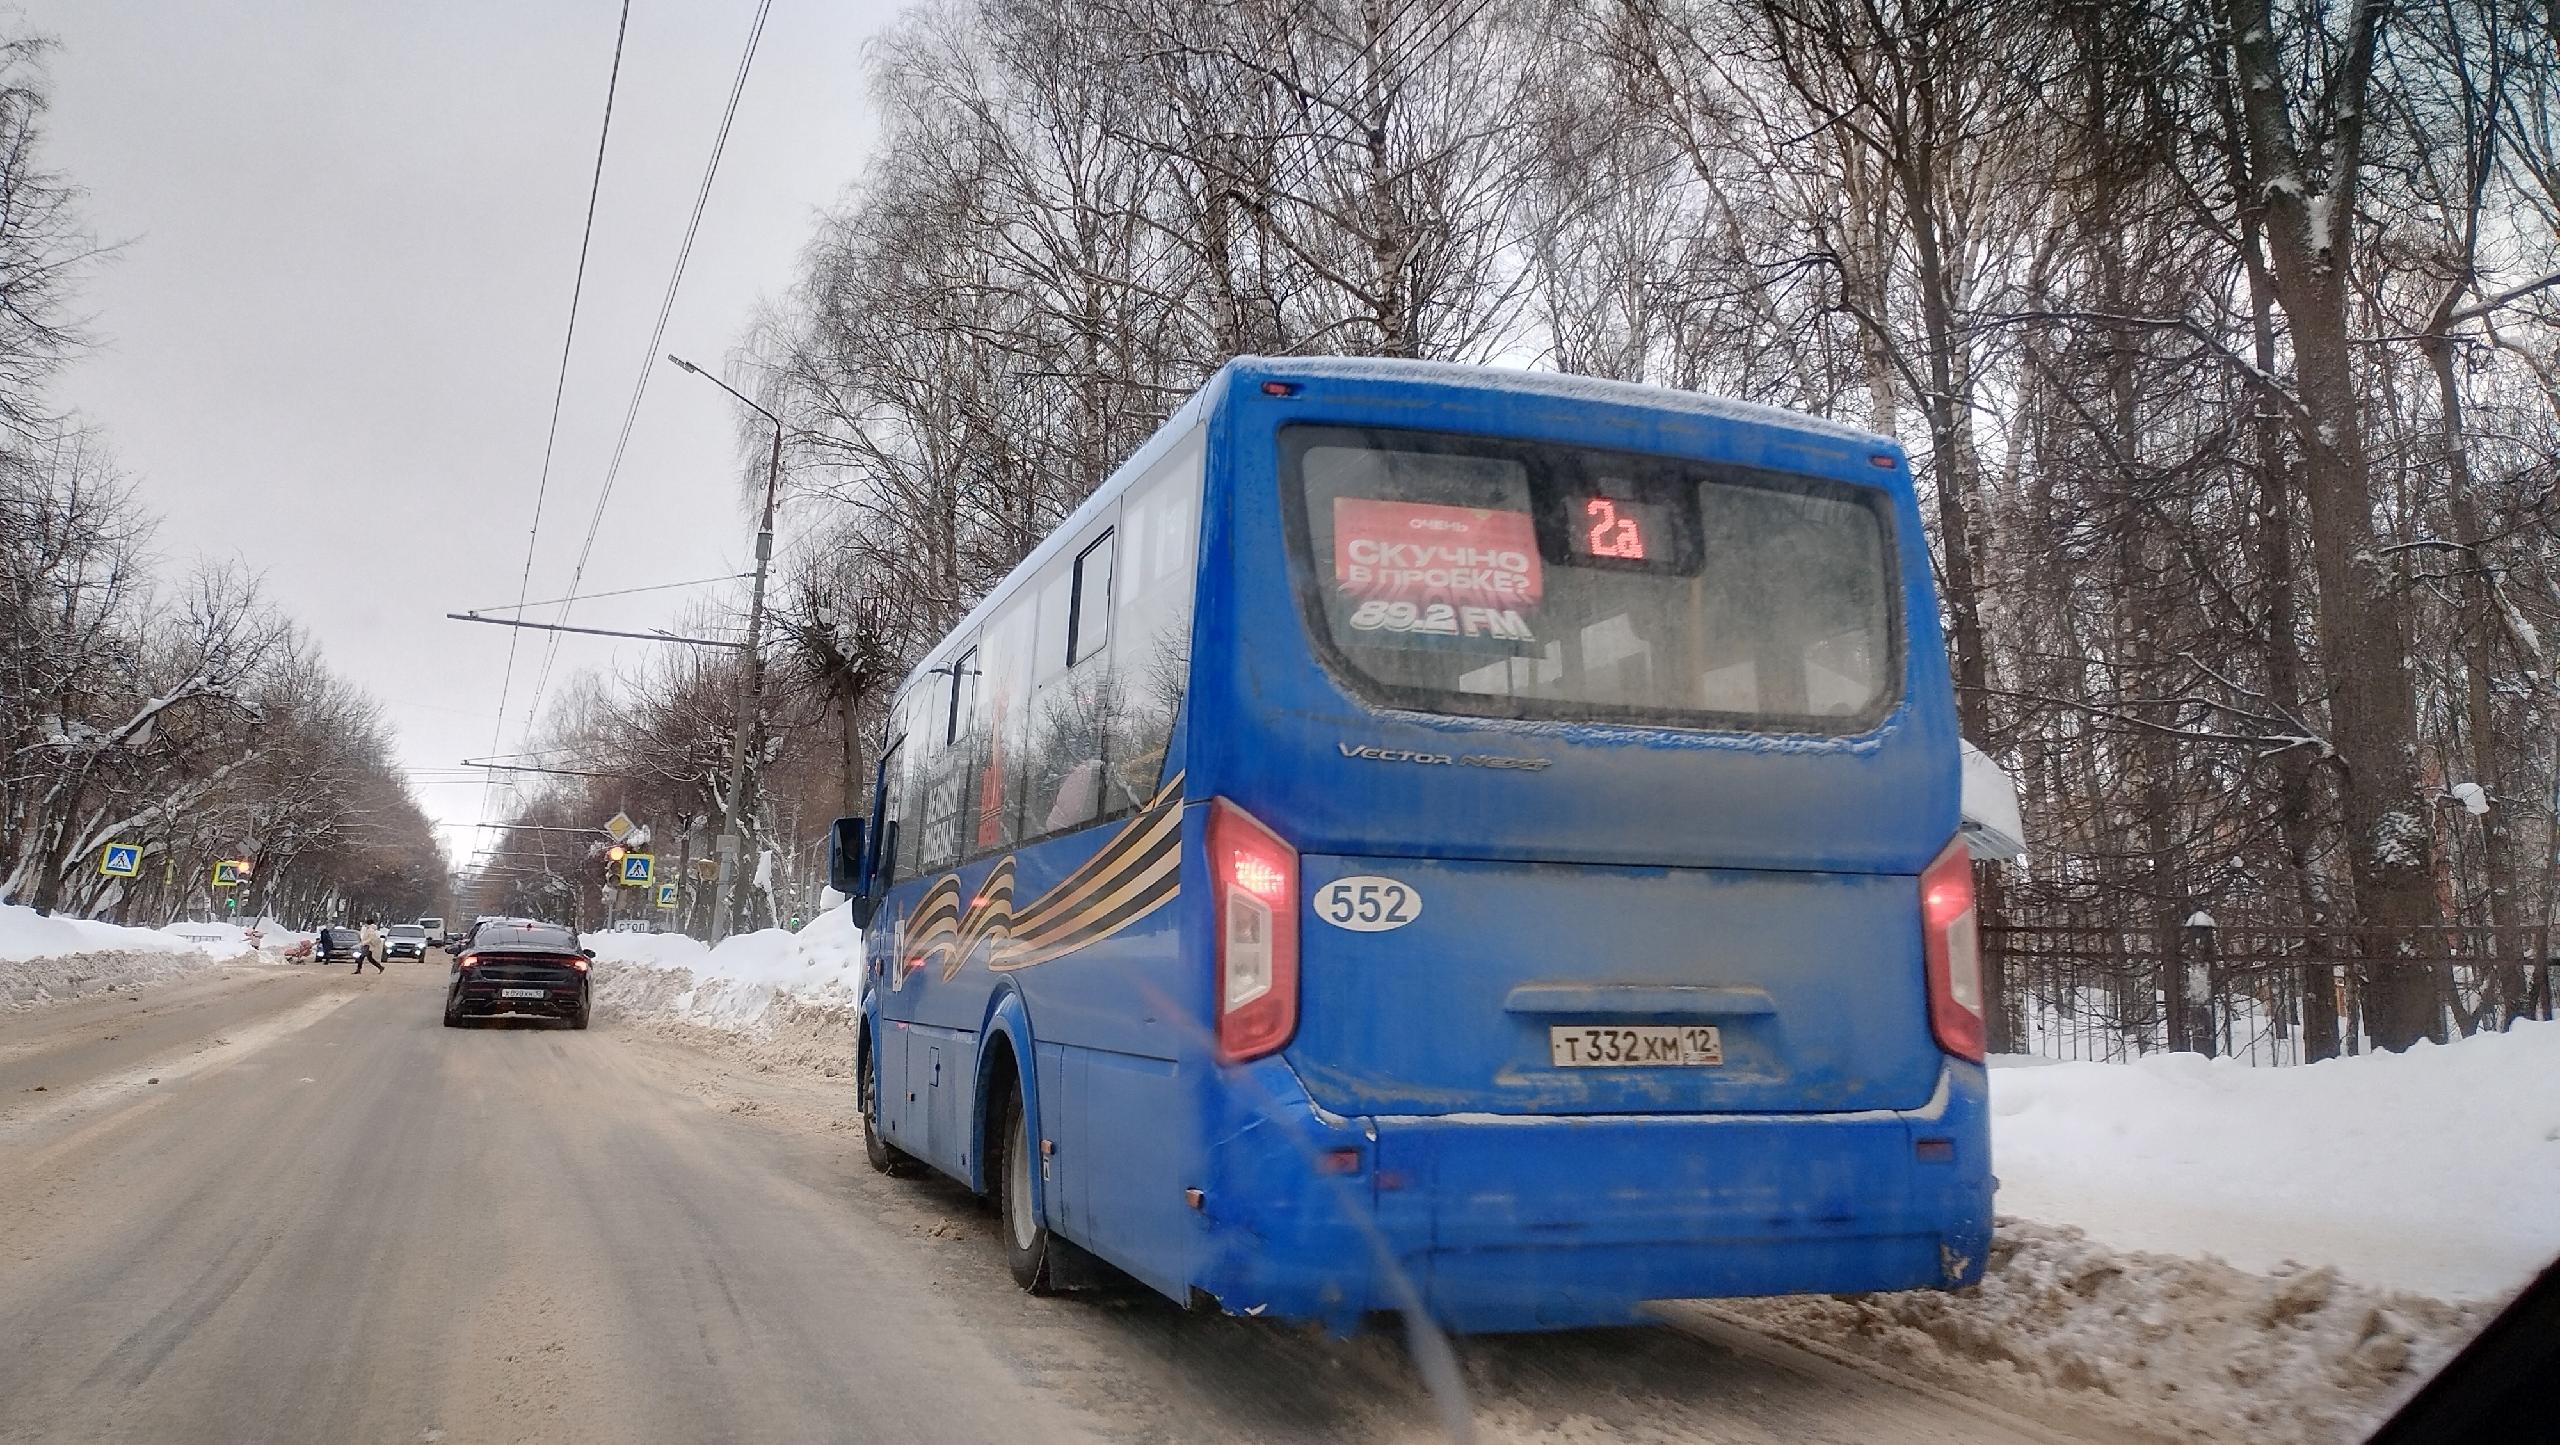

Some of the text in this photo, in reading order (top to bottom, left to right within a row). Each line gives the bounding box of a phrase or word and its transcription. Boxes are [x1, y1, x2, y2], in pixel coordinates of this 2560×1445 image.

[1409, 518, 1469, 533] ОЧЕНЬ
[1348, 539, 1530, 574] СКУЧНО
[1350, 564, 1530, 595] В ПРОБКЕ?
[1350, 601, 1537, 642] 89.2 FM
[1338, 742, 1453, 765] VECTOR
[1331, 885, 1408, 923] 552
[619, 922, 645, 932] СТОП
[1685, 1029, 1711, 1053] 12
